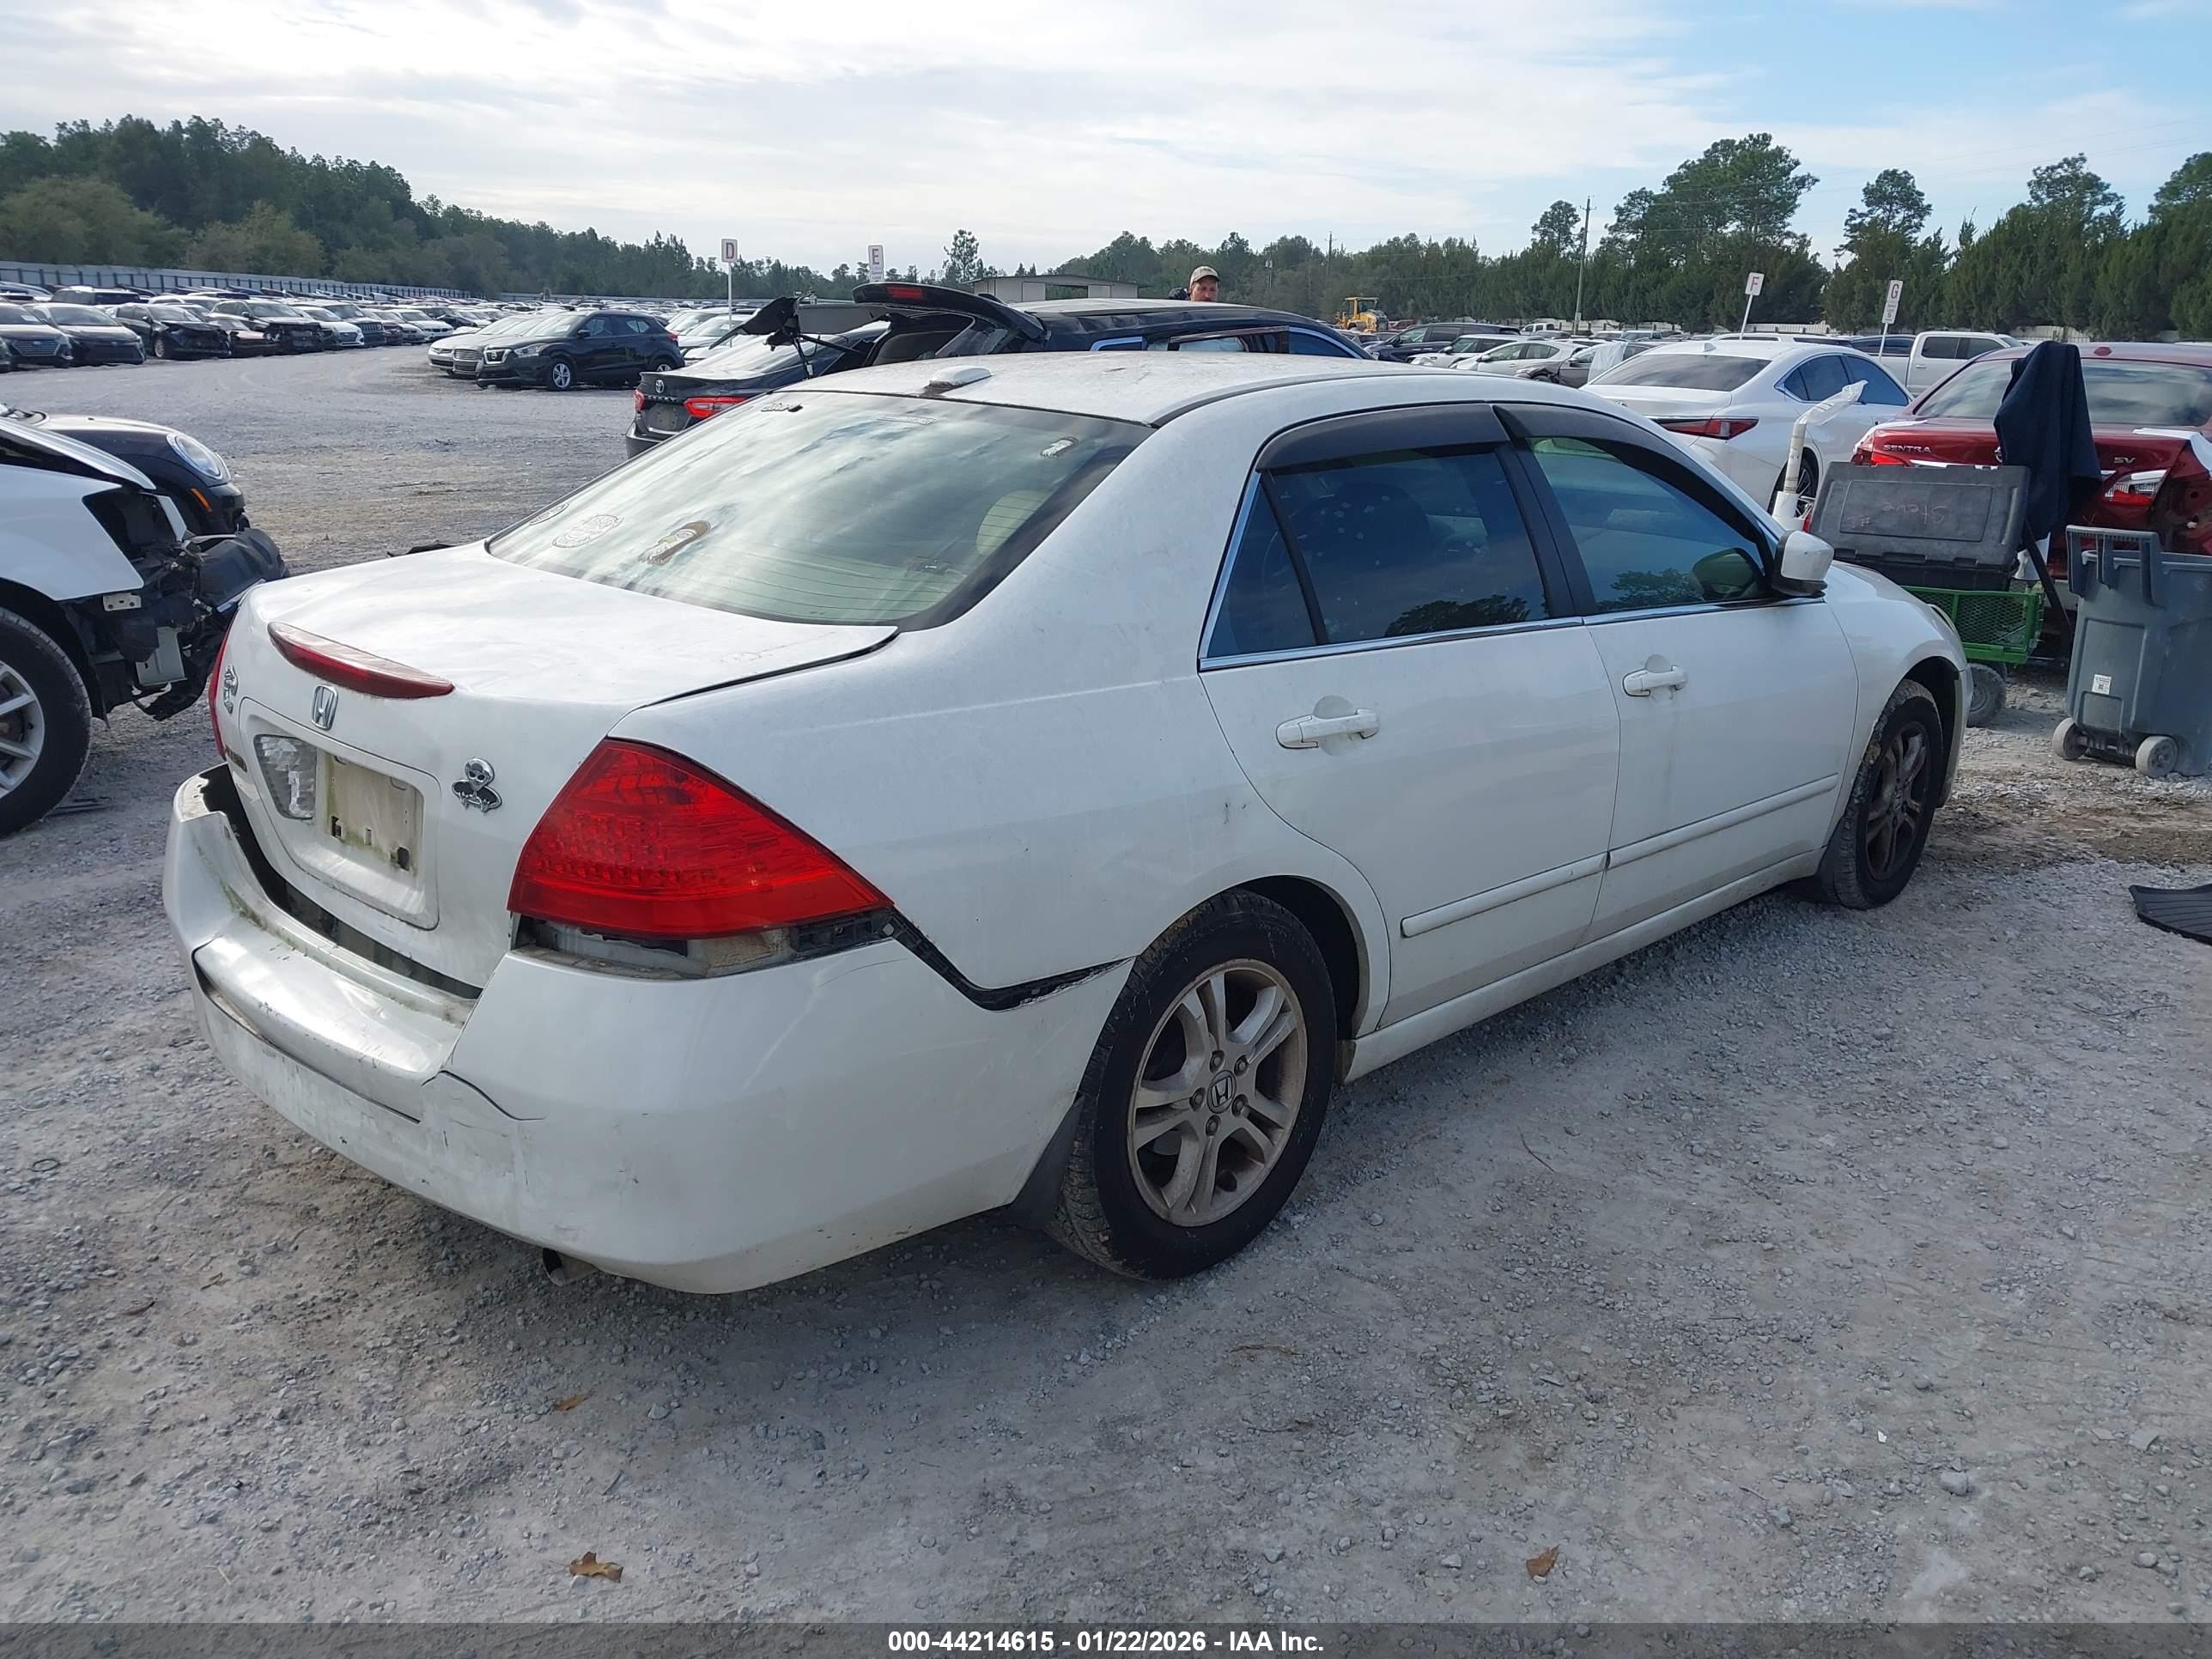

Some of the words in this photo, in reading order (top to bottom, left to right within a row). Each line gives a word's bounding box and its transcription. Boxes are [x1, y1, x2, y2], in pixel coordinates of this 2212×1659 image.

[726, 242, 735, 259] D
[872, 248, 880, 265] E
[1750, 276, 1759, 291] F
[1891, 283, 1899, 299] G
[1882, 443, 1931, 453] SENTRA
